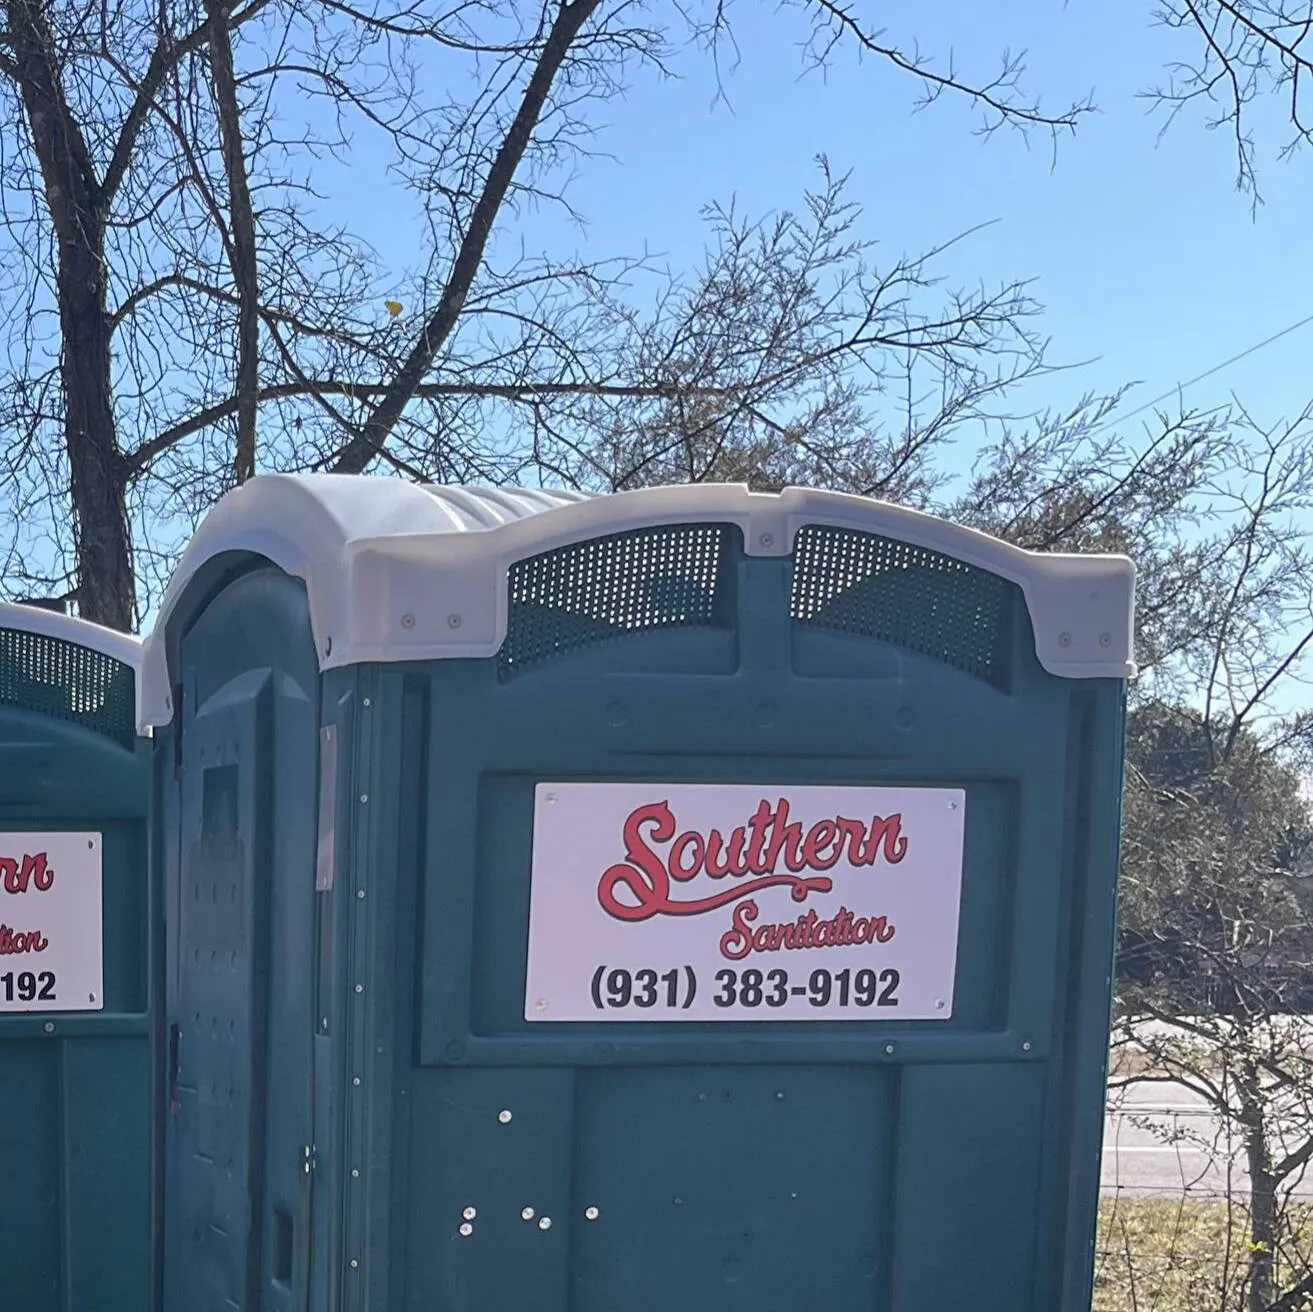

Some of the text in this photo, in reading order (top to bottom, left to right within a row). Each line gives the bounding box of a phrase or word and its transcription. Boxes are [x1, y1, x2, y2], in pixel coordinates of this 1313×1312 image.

[597, 798, 908, 922] Southern
[719, 899, 895, 960] Sanitation
[591, 965, 900, 1009] (931) 383-9192
